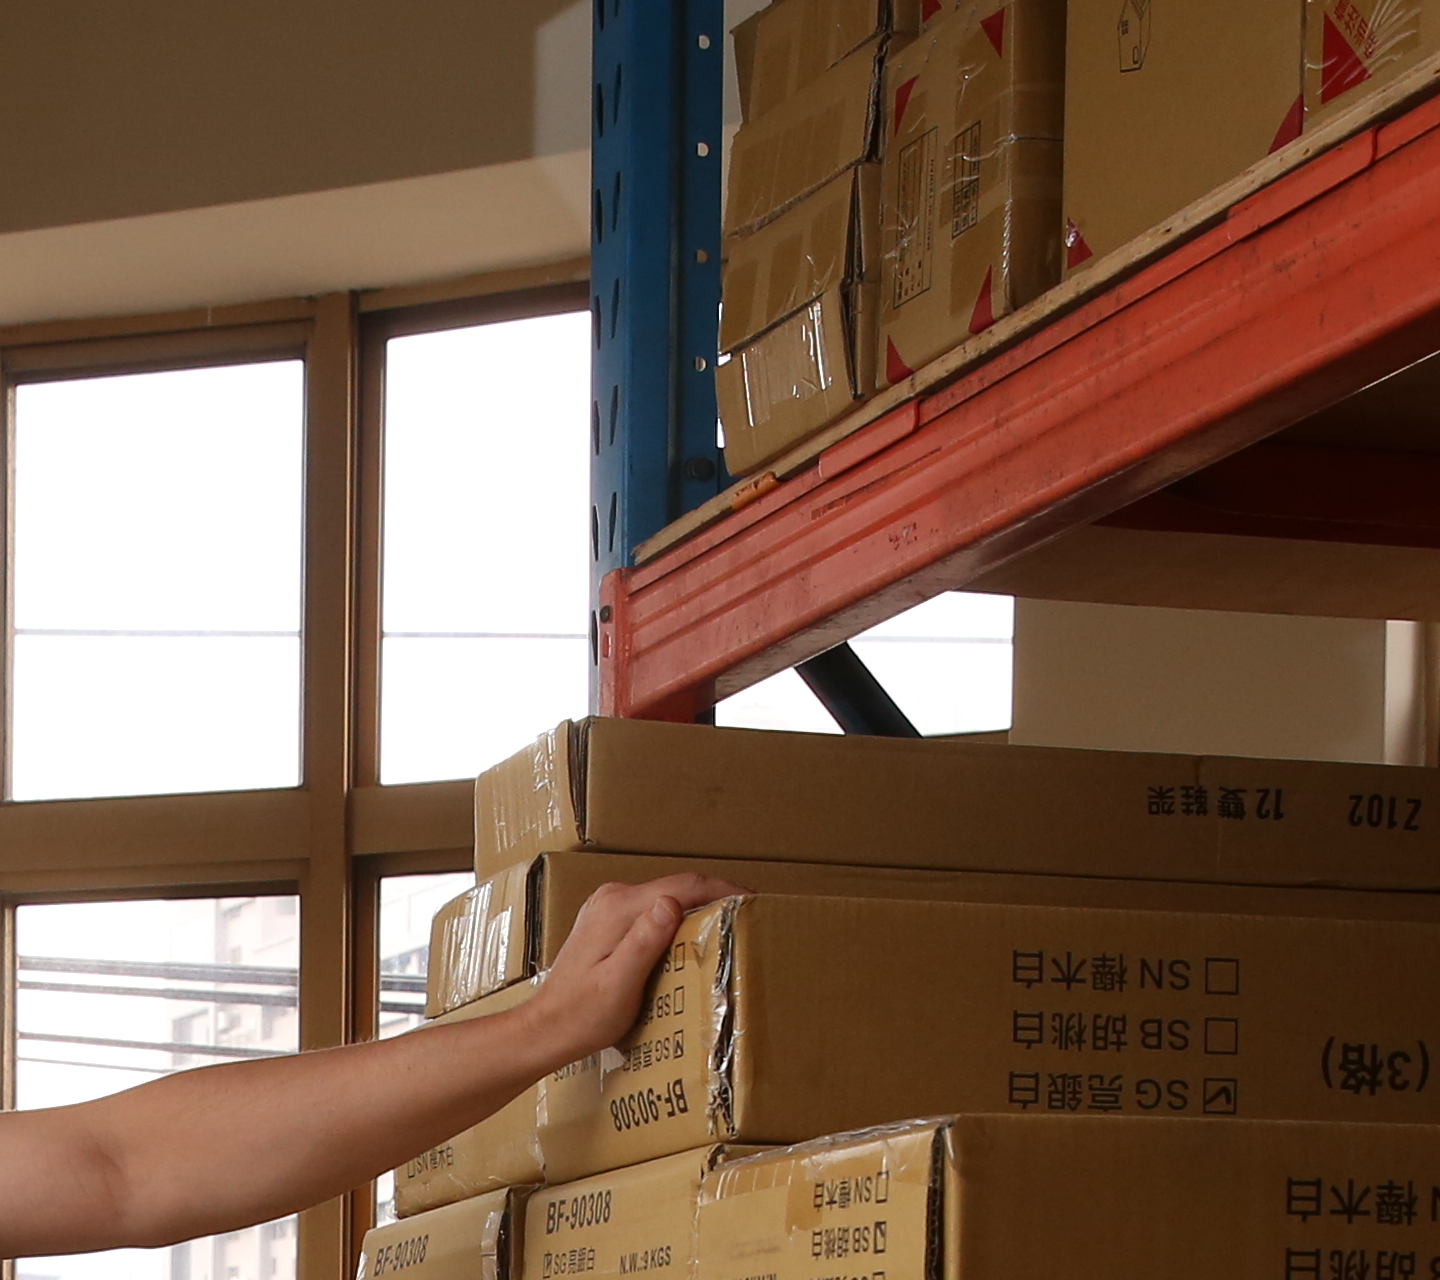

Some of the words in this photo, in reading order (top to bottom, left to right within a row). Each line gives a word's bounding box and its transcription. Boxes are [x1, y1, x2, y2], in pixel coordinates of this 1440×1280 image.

[1148, 774, 1247, 820] 雙鞋架
[1256, 788, 1284, 820] 12
[1348, 794, 1421, 831] Z102
[1322, 1036, 1429, 1096] (3格)
